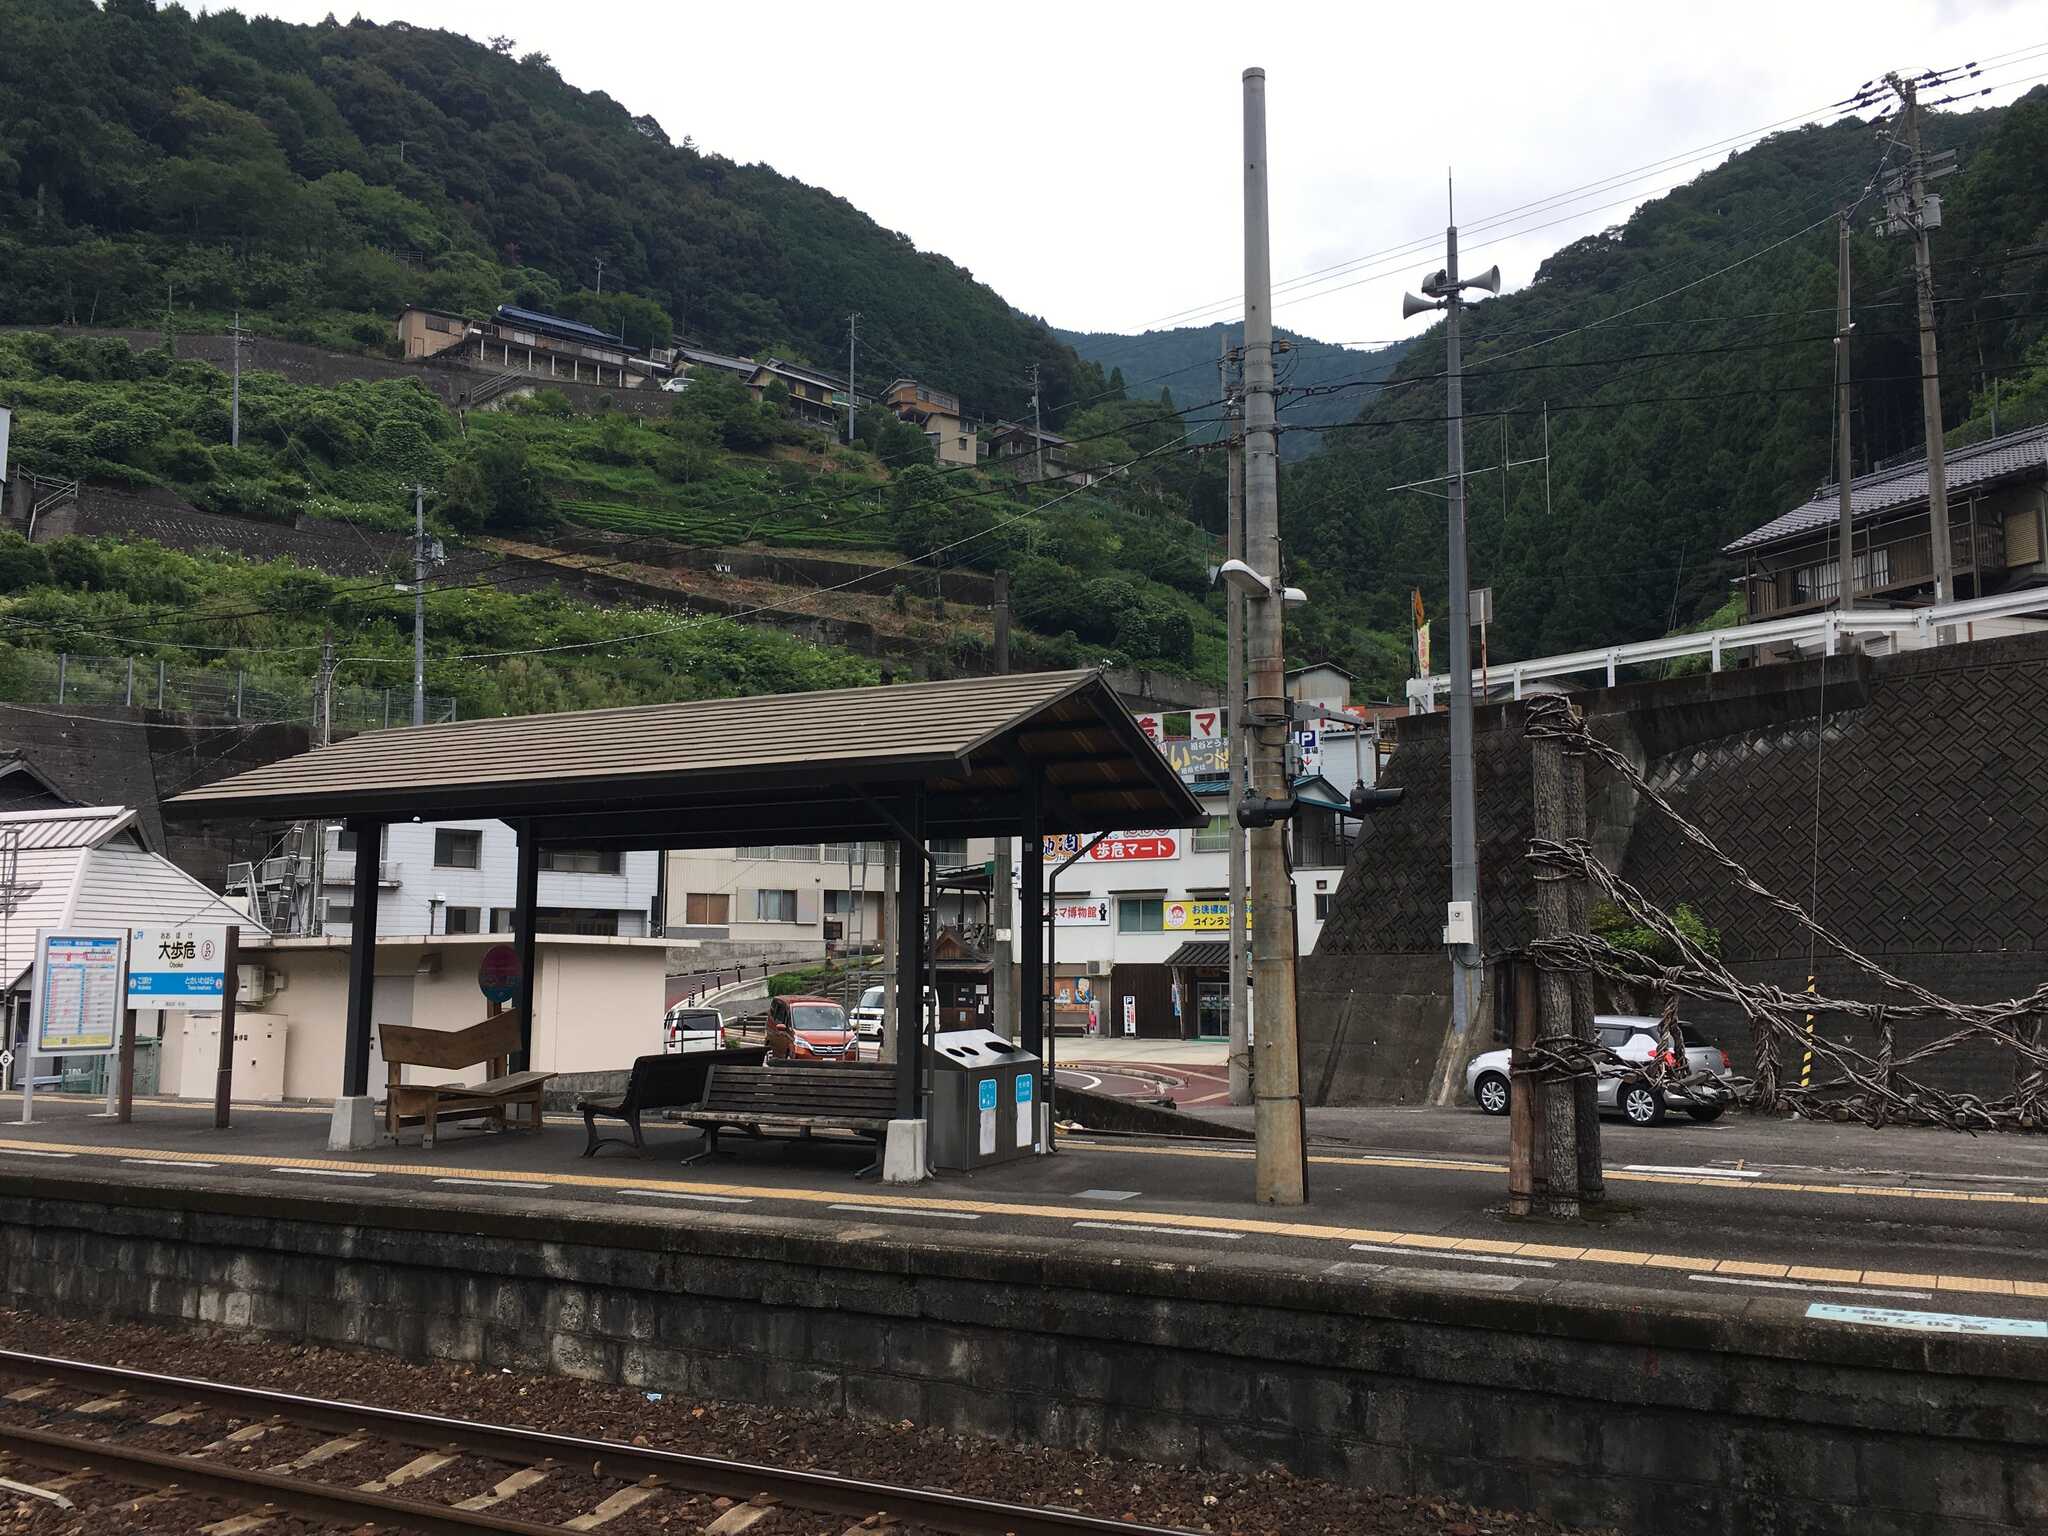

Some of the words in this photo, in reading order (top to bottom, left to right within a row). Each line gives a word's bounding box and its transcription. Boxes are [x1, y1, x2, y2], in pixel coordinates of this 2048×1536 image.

[1195, 713, 1216, 736] マ
[1301, 731, 1313, 746] P
[1097, 841, 1167, 858] 歩危マート
[158, 941, 196, 960] 大歩危
[2, 1055, 9, 1064] 6
